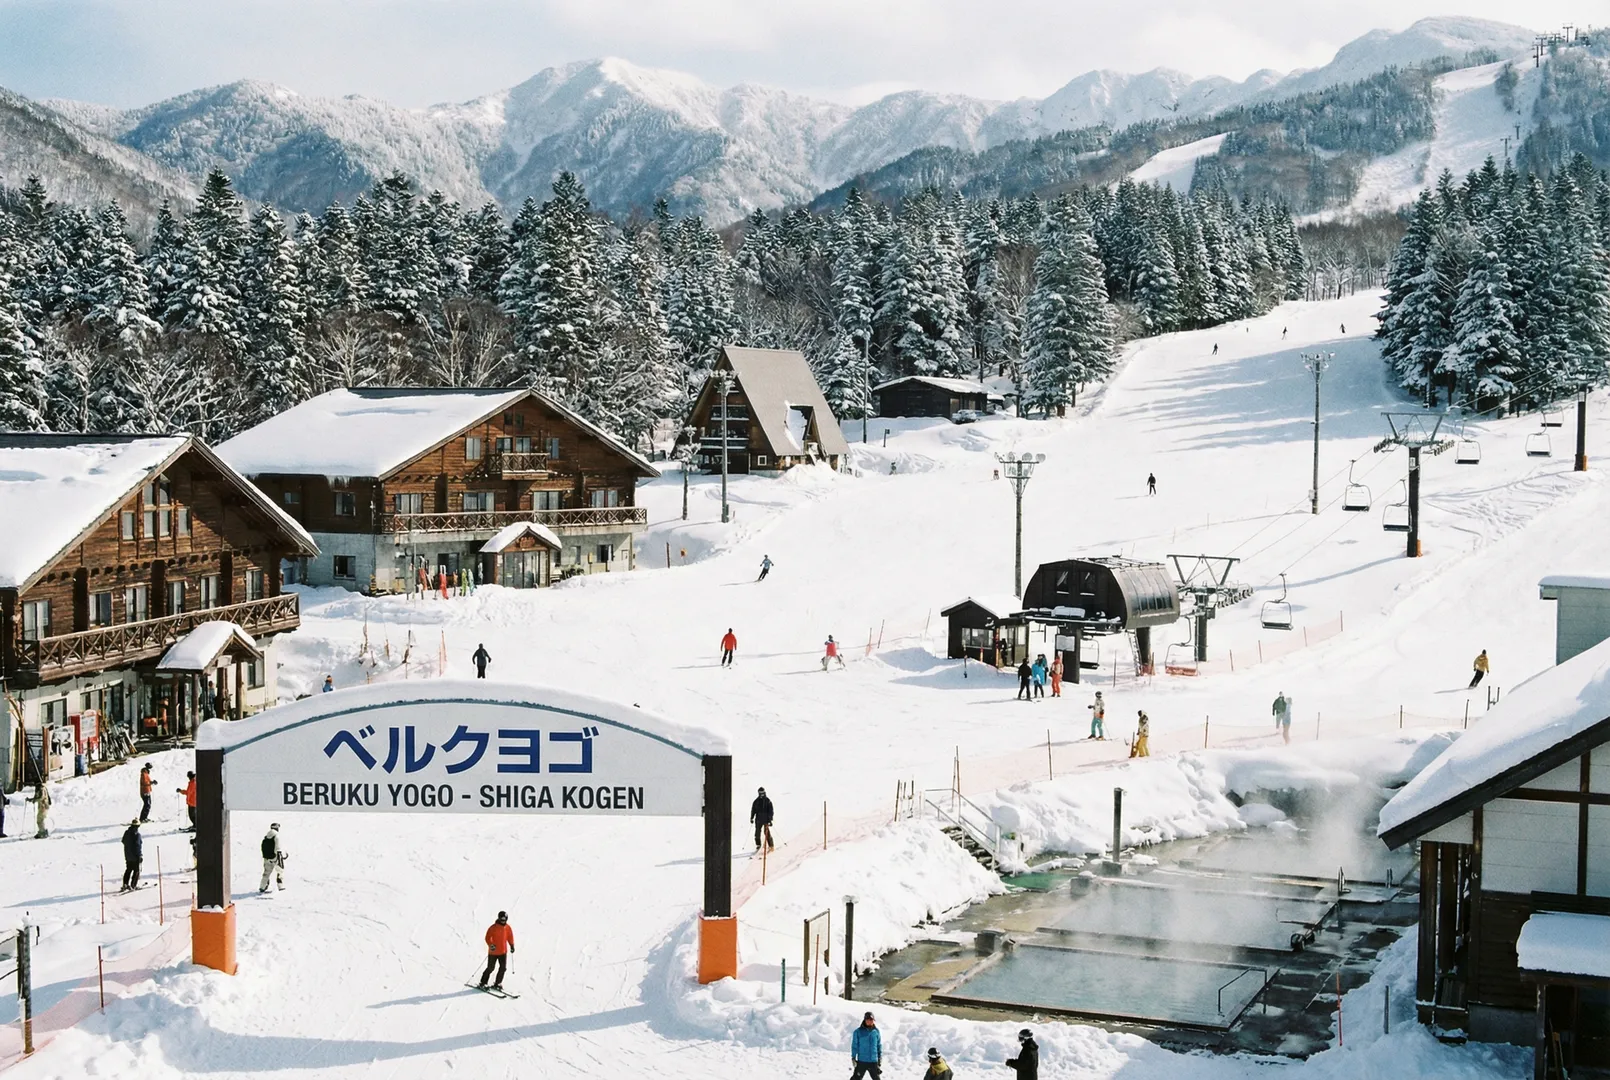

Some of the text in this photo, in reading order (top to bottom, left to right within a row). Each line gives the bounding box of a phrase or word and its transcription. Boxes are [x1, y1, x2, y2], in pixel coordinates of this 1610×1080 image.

[322, 724, 600, 775] ベルクヨゴ
[283, 782, 379, 807] BERUKU
[387, 783, 454, 808] YOGO
[479, 784, 555, 809] SHIGA
[562, 785, 645, 810] KOGEN
